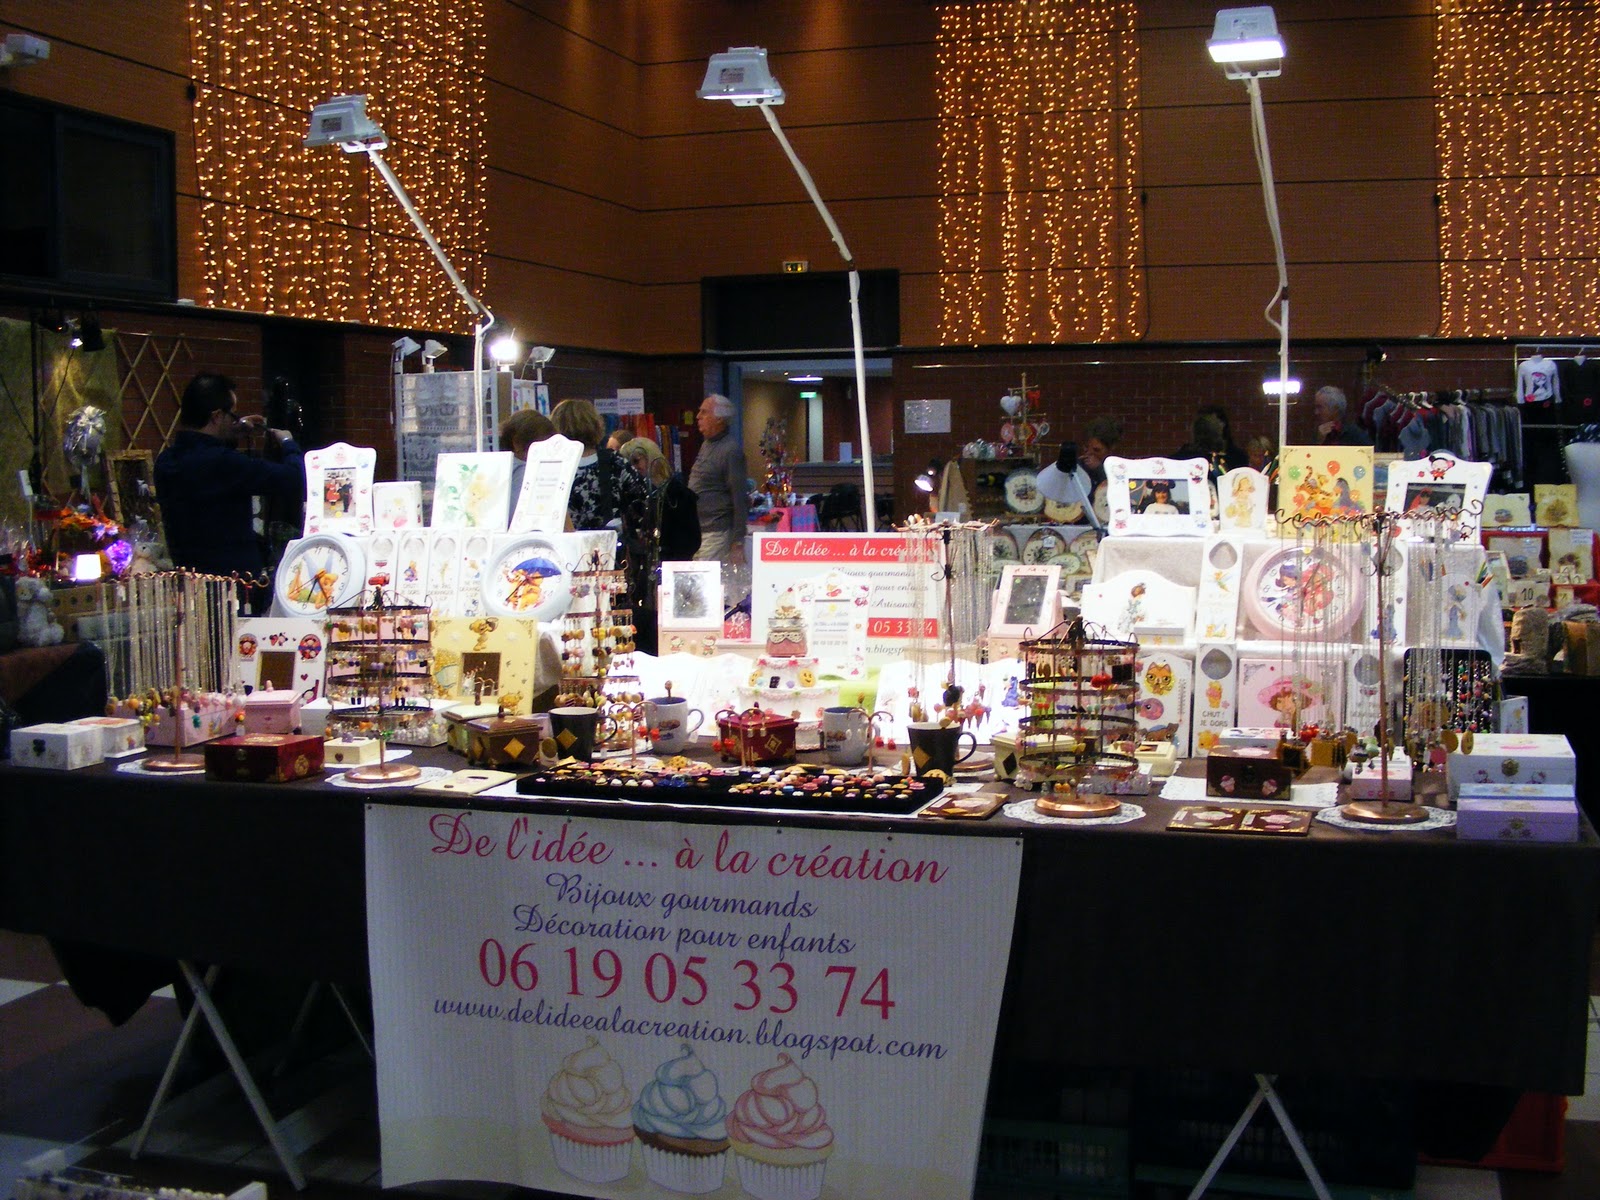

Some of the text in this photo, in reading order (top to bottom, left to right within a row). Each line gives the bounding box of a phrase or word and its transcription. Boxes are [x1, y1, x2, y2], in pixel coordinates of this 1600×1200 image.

[765, 540, 790, 556] De
[793, 541, 829, 557] l'idée
[849, 543, 860, 557] à
[862, 541, 879, 557] la
[1521, 587, 1534, 601] 10
[874, 620, 891, 634] 05
[429, 811, 498, 857] De
[506, 816, 614, 865] l'idée
[675, 837, 703, 870] à
[714, 829, 759, 875] la
[767, 844, 950, 884] création
[545, 872, 818, 919] Bijoux gourmands
[513, 903, 857, 963] Décoration pour enfants
[479, 938, 896, 1020] 06 19 05 33 74
[433, 997, 949, 1060] www.delideealacreation.blogspot.com
